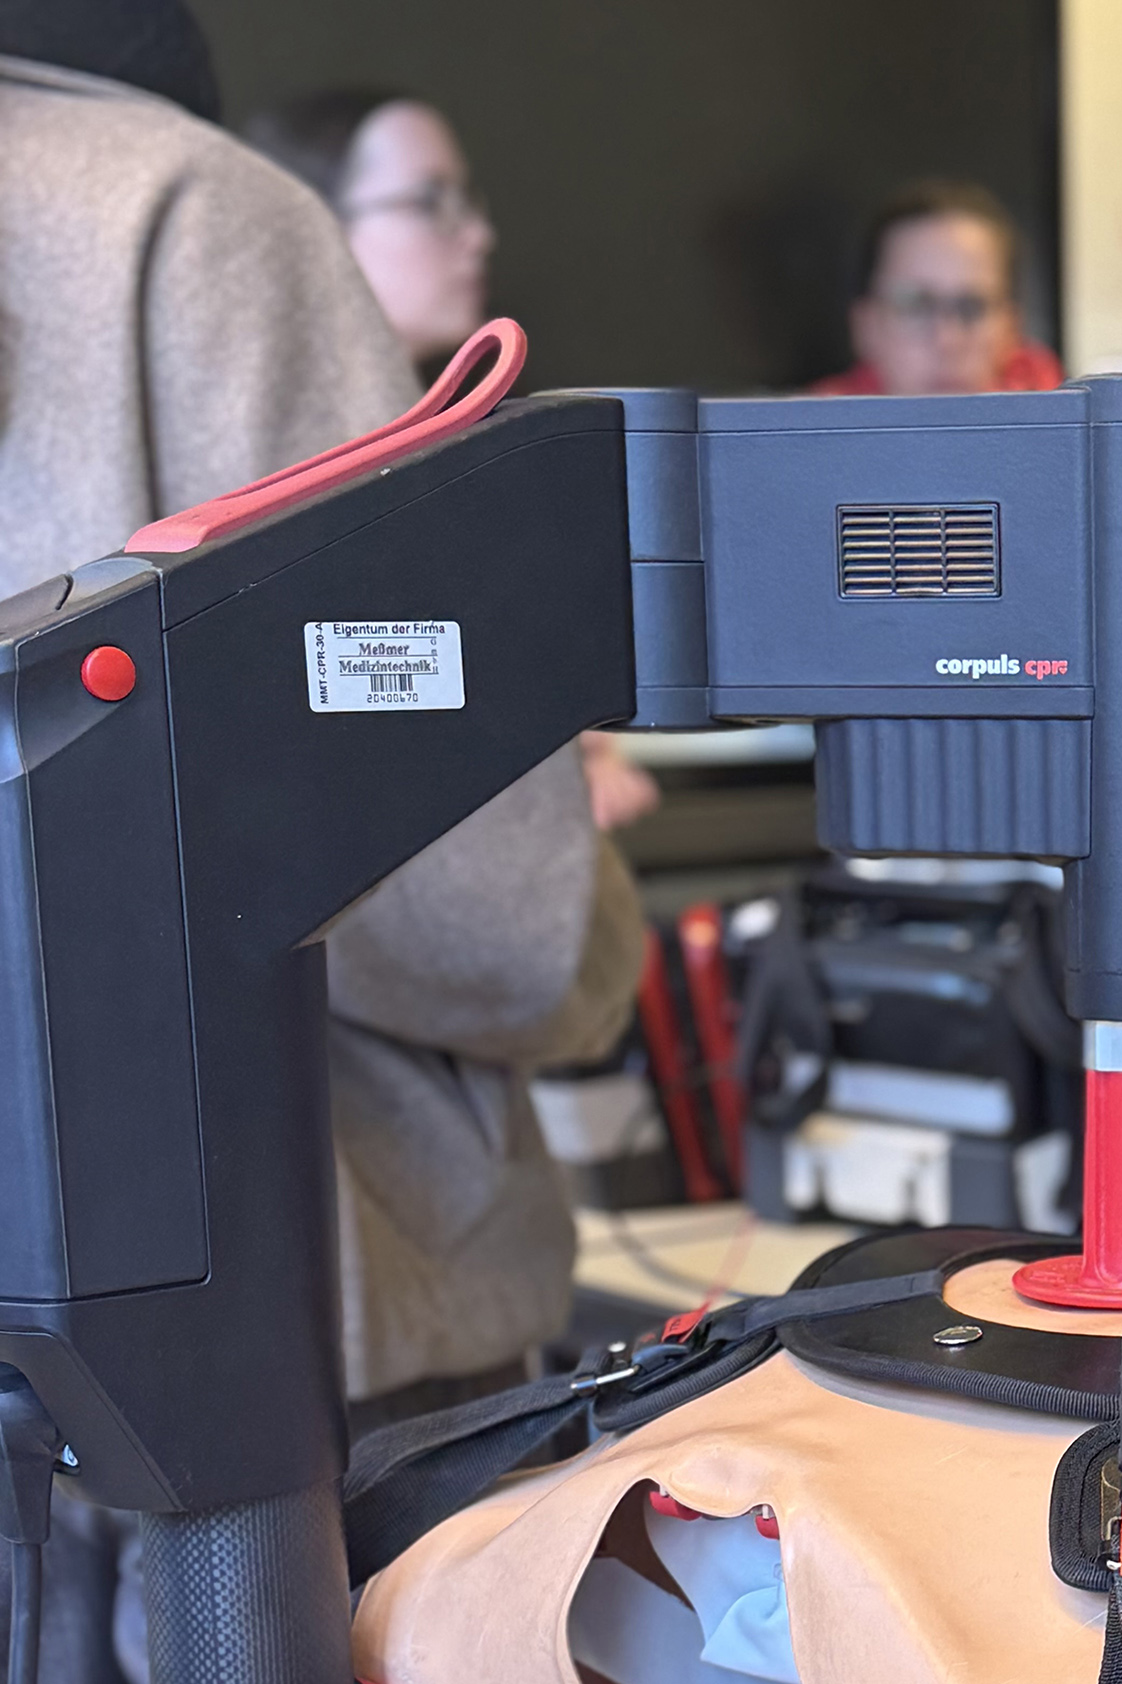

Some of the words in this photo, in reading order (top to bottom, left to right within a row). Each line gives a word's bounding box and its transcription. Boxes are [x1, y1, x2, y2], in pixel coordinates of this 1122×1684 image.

[333, 623, 388, 637] Eigentum
[392, 623, 410, 635] der
[413, 623, 445, 635] Firma
[359, 643, 410, 656] Meßmer
[339, 660, 432, 674] Medizintechnik
[935, 653, 1021, 680] corpuls
